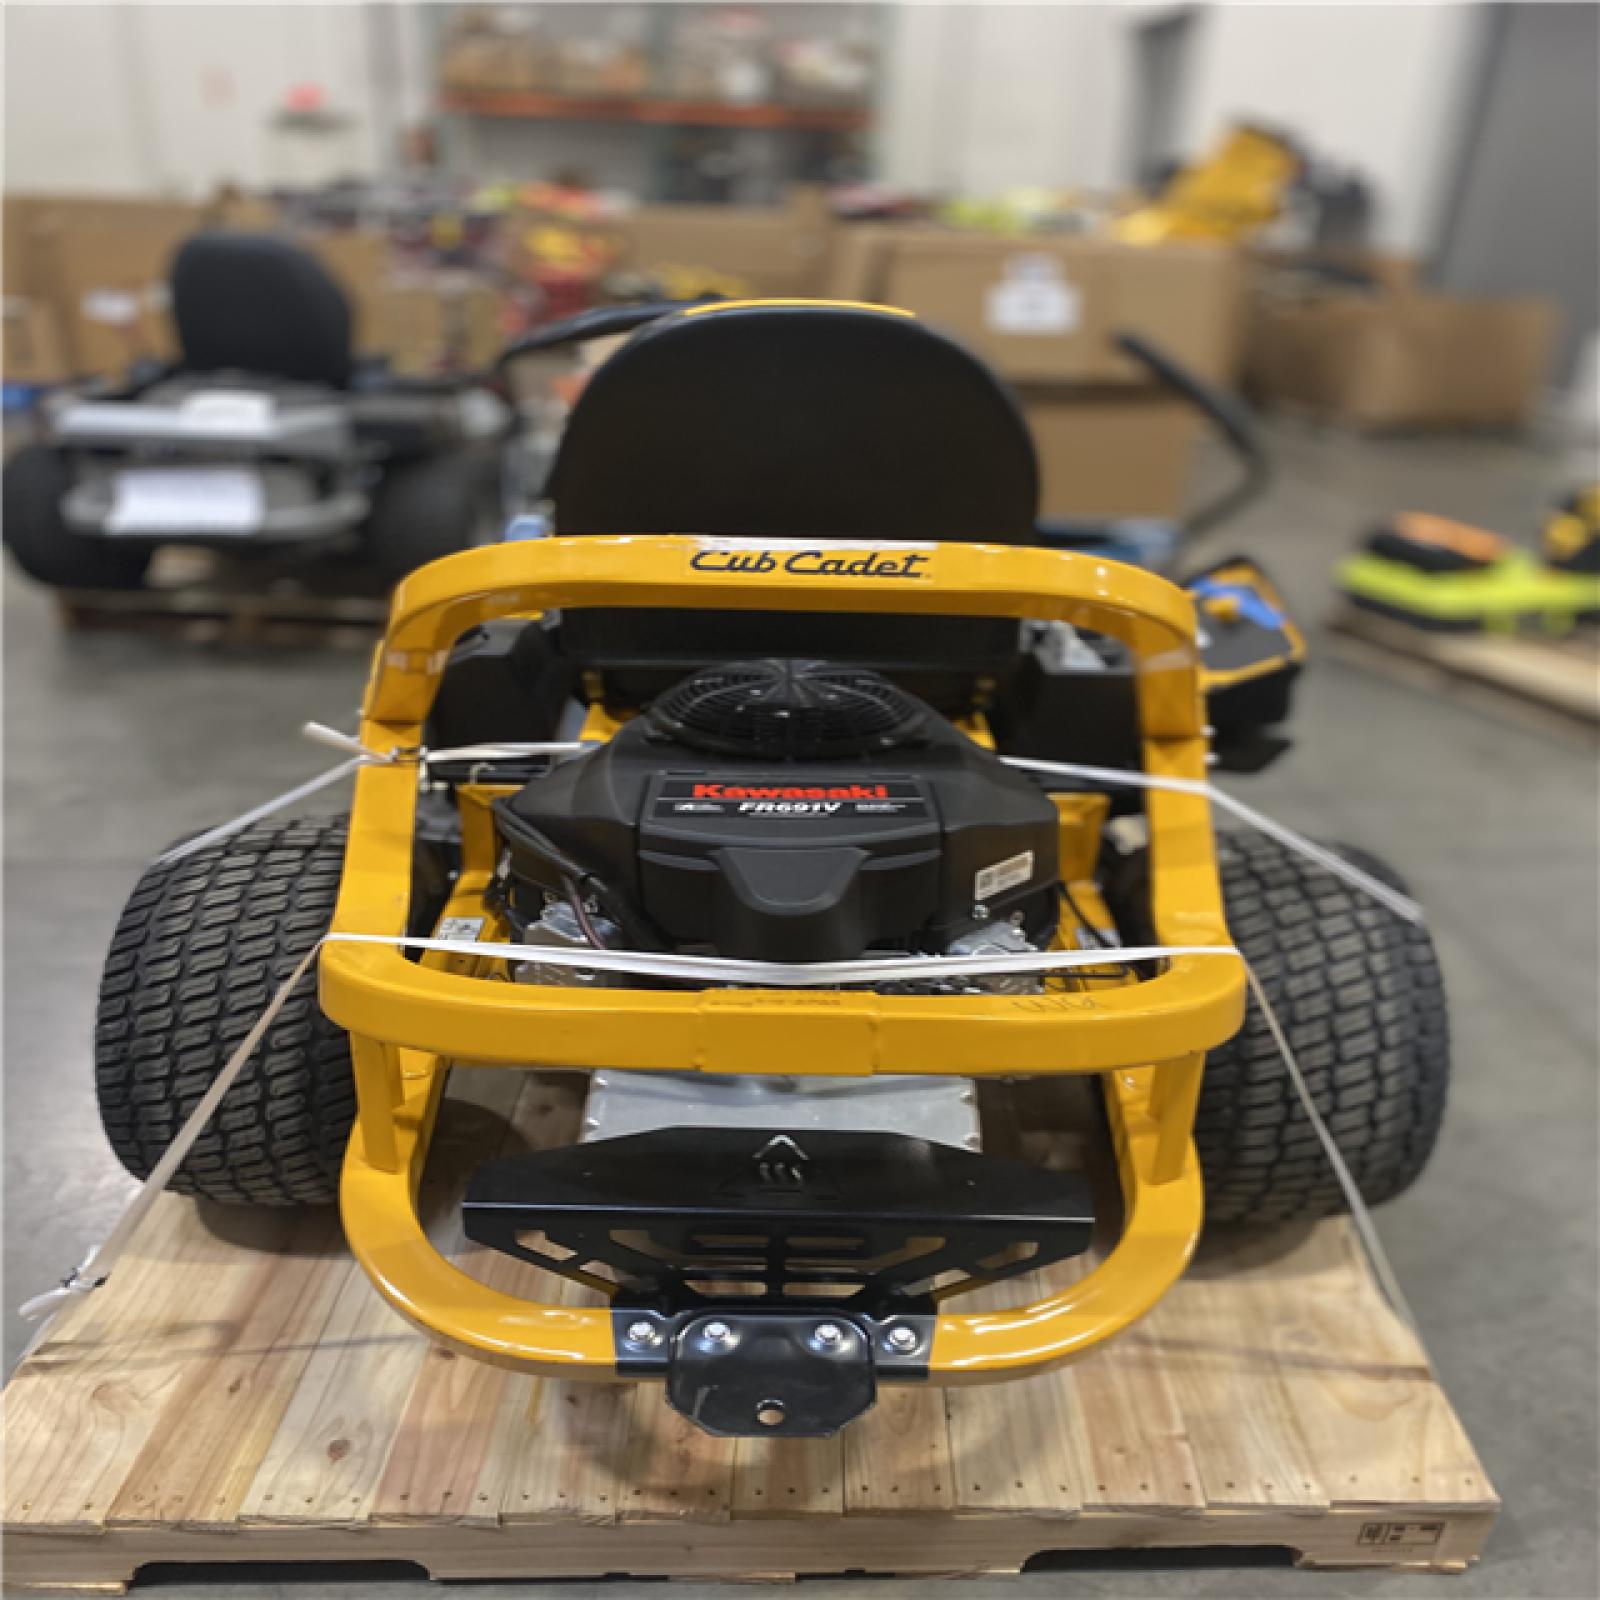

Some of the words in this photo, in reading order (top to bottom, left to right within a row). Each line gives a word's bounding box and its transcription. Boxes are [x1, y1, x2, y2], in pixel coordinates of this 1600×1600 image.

[690, 550, 777, 572] Cub
[784, 550, 930, 578] Cadet
[692, 784, 888, 799] Kawasaki
